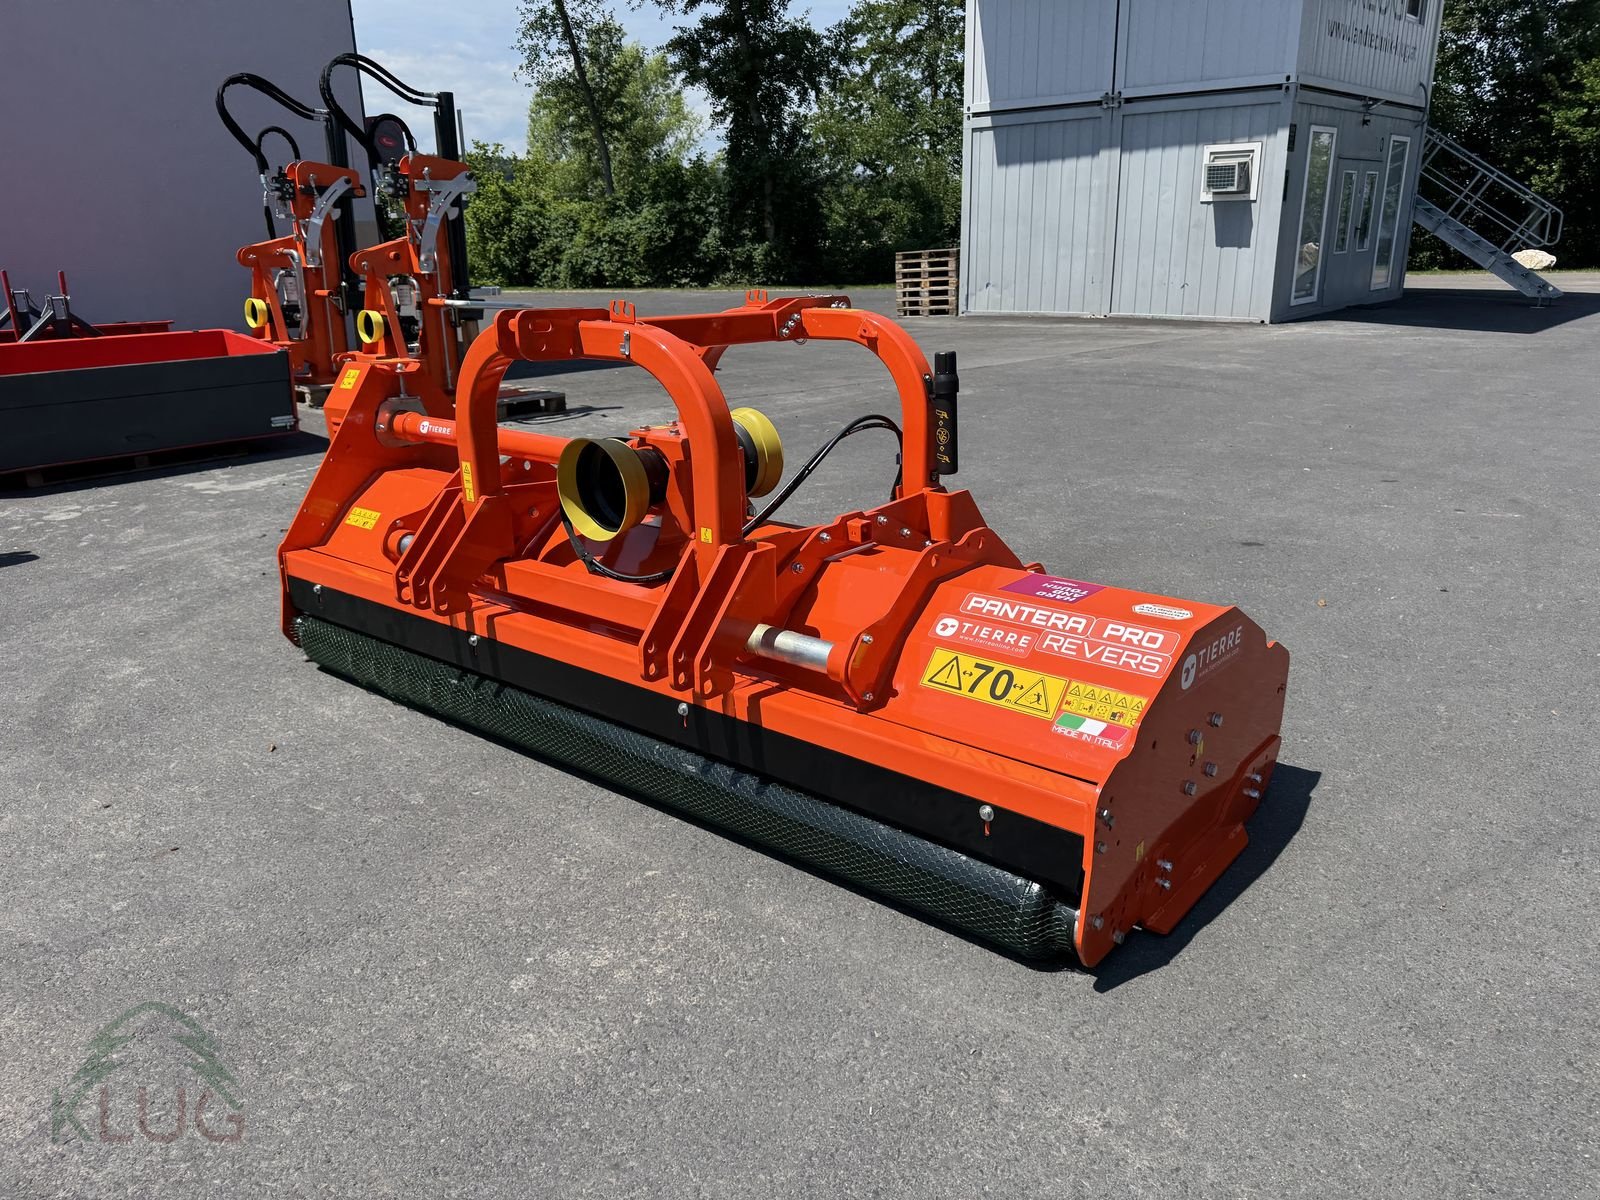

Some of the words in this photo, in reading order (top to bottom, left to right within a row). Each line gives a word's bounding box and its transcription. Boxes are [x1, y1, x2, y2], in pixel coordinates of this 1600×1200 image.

[429, 424, 451, 435] TIERRE
[1035, 591, 1077, 602] HARD
[1042, 583, 1089, 595] TOUGH
[1052, 589, 1084, 598] AND
[961, 622, 1032, 648] TIERRE
[966, 596, 1087, 633] PANTERA
[1102, 624, 1165, 649] PRO
[1042, 634, 1163, 673] REVERS
[1198, 625, 1242, 668] TIERRE
[967, 662, 1015, 701] 70
[1051, 725, 1079, 739] MADE
[1082, 733, 1092, 743] IN
[1094, 737, 1123, 751] ITALY
